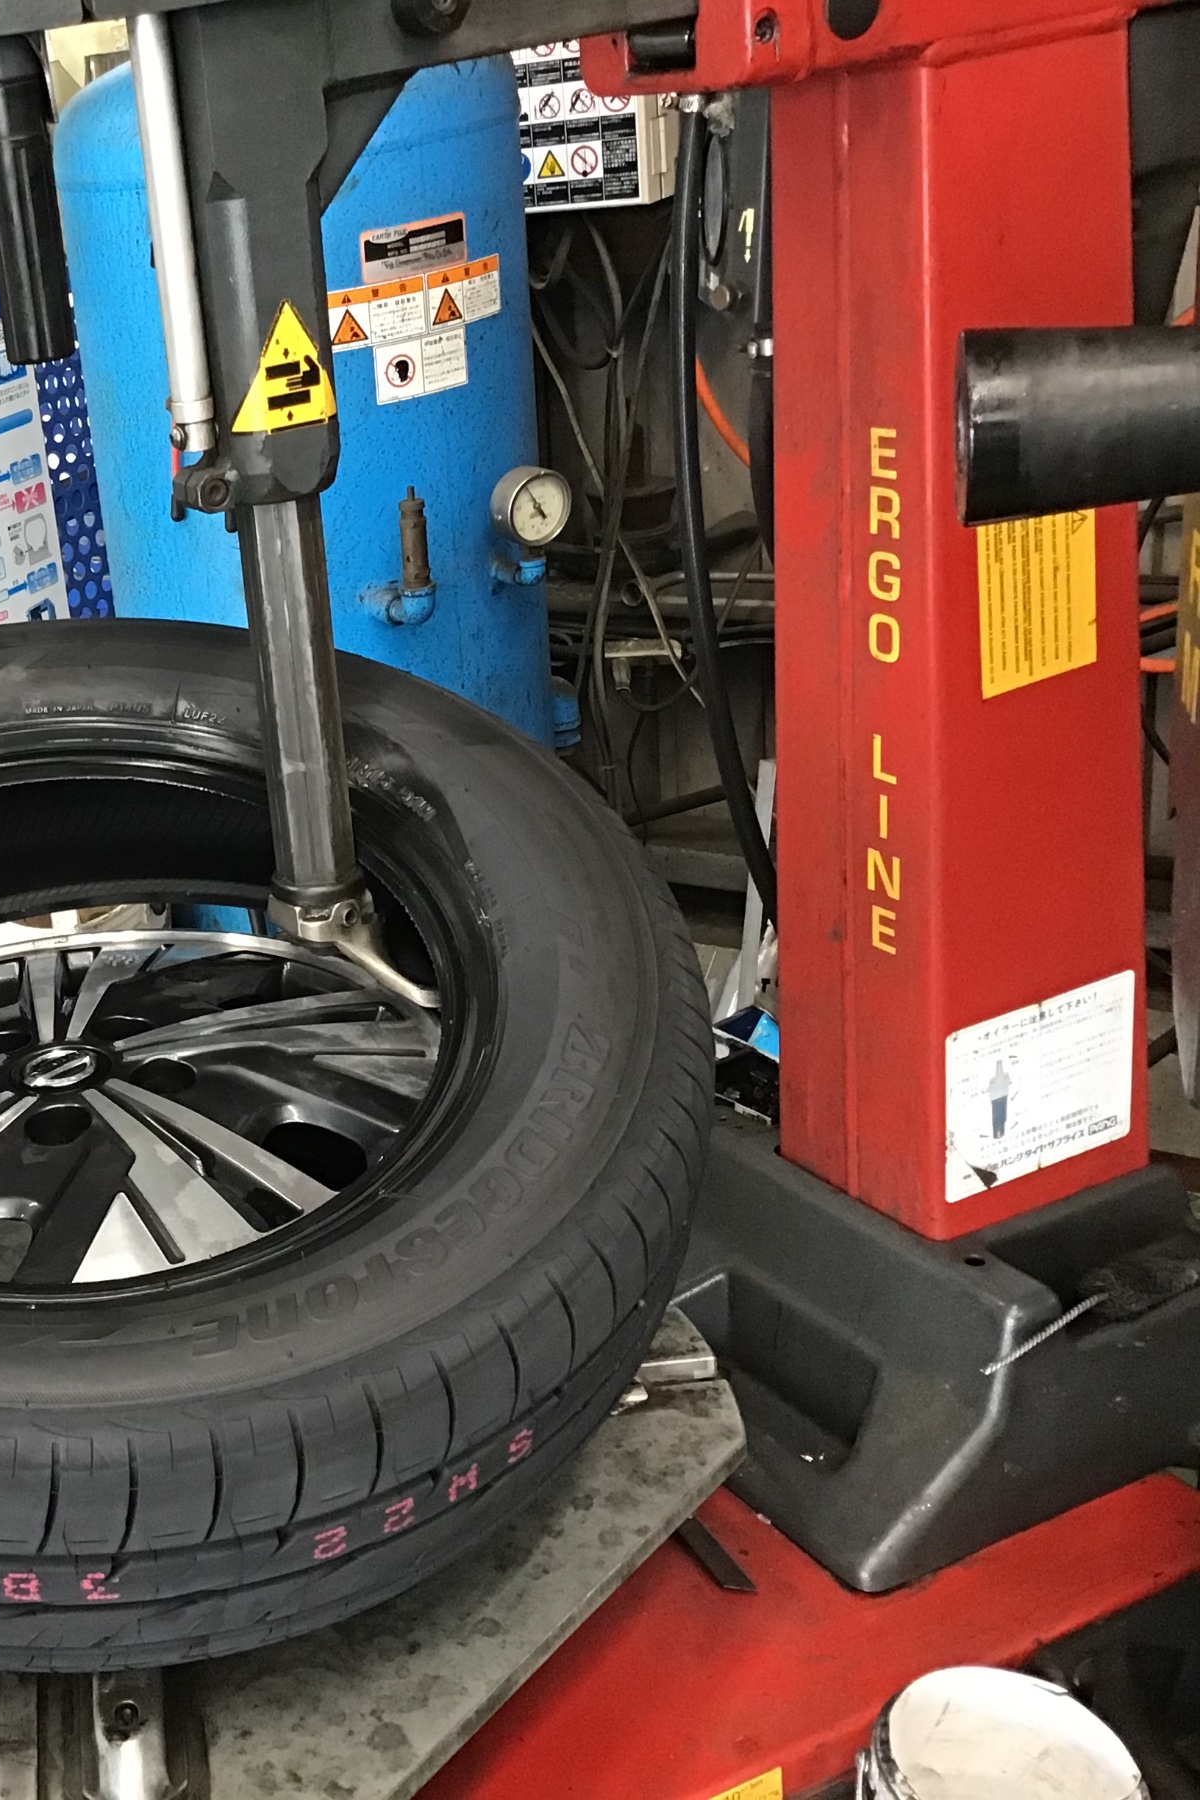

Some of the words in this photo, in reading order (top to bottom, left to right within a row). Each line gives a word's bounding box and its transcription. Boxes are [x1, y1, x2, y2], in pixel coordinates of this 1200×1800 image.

[868, 427, 901, 664] ERGO
[25, 705, 49, 714] MADE
[866, 733, 901, 955] LINE
[191, 1022, 614, 1358] BRIDGESTONE
